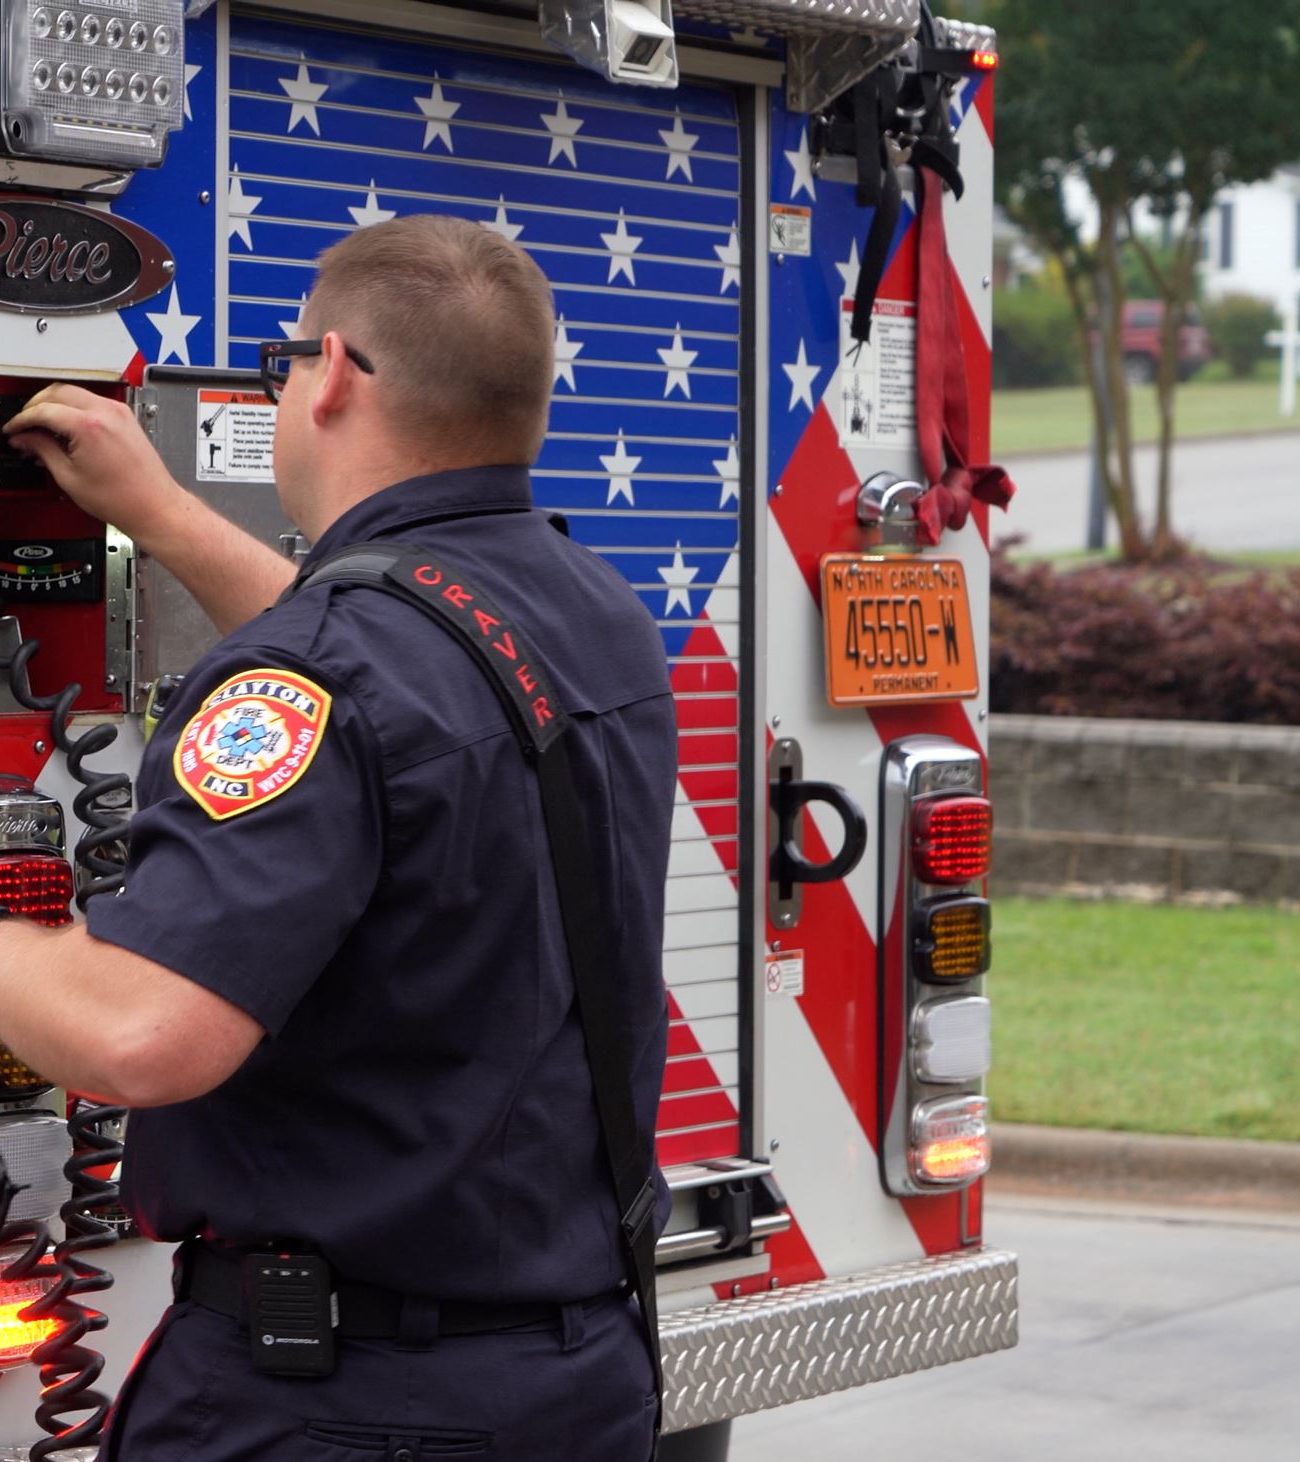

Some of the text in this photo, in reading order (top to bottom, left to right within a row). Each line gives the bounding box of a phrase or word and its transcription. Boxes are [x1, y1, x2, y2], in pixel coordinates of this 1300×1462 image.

[2, 580, 10, 588] 10
[16, 582, 22, 590] 5
[45, 582, 51, 590] 5
[58, 580, 67, 588] 10
[72, 575, 81, 584] 15
[832, 567, 883, 591] NORTH
[845, 595, 960, 670] 45550-W
[413, 565, 555, 727] CRAVER
[872, 672, 939, 692] PERMANENT
[233, 707, 266, 718] FIRE
[216, 755, 254, 769] DEPT
[257, 728, 316, 793] WTC 9-11-01
[209, 778, 244, 796] NC
